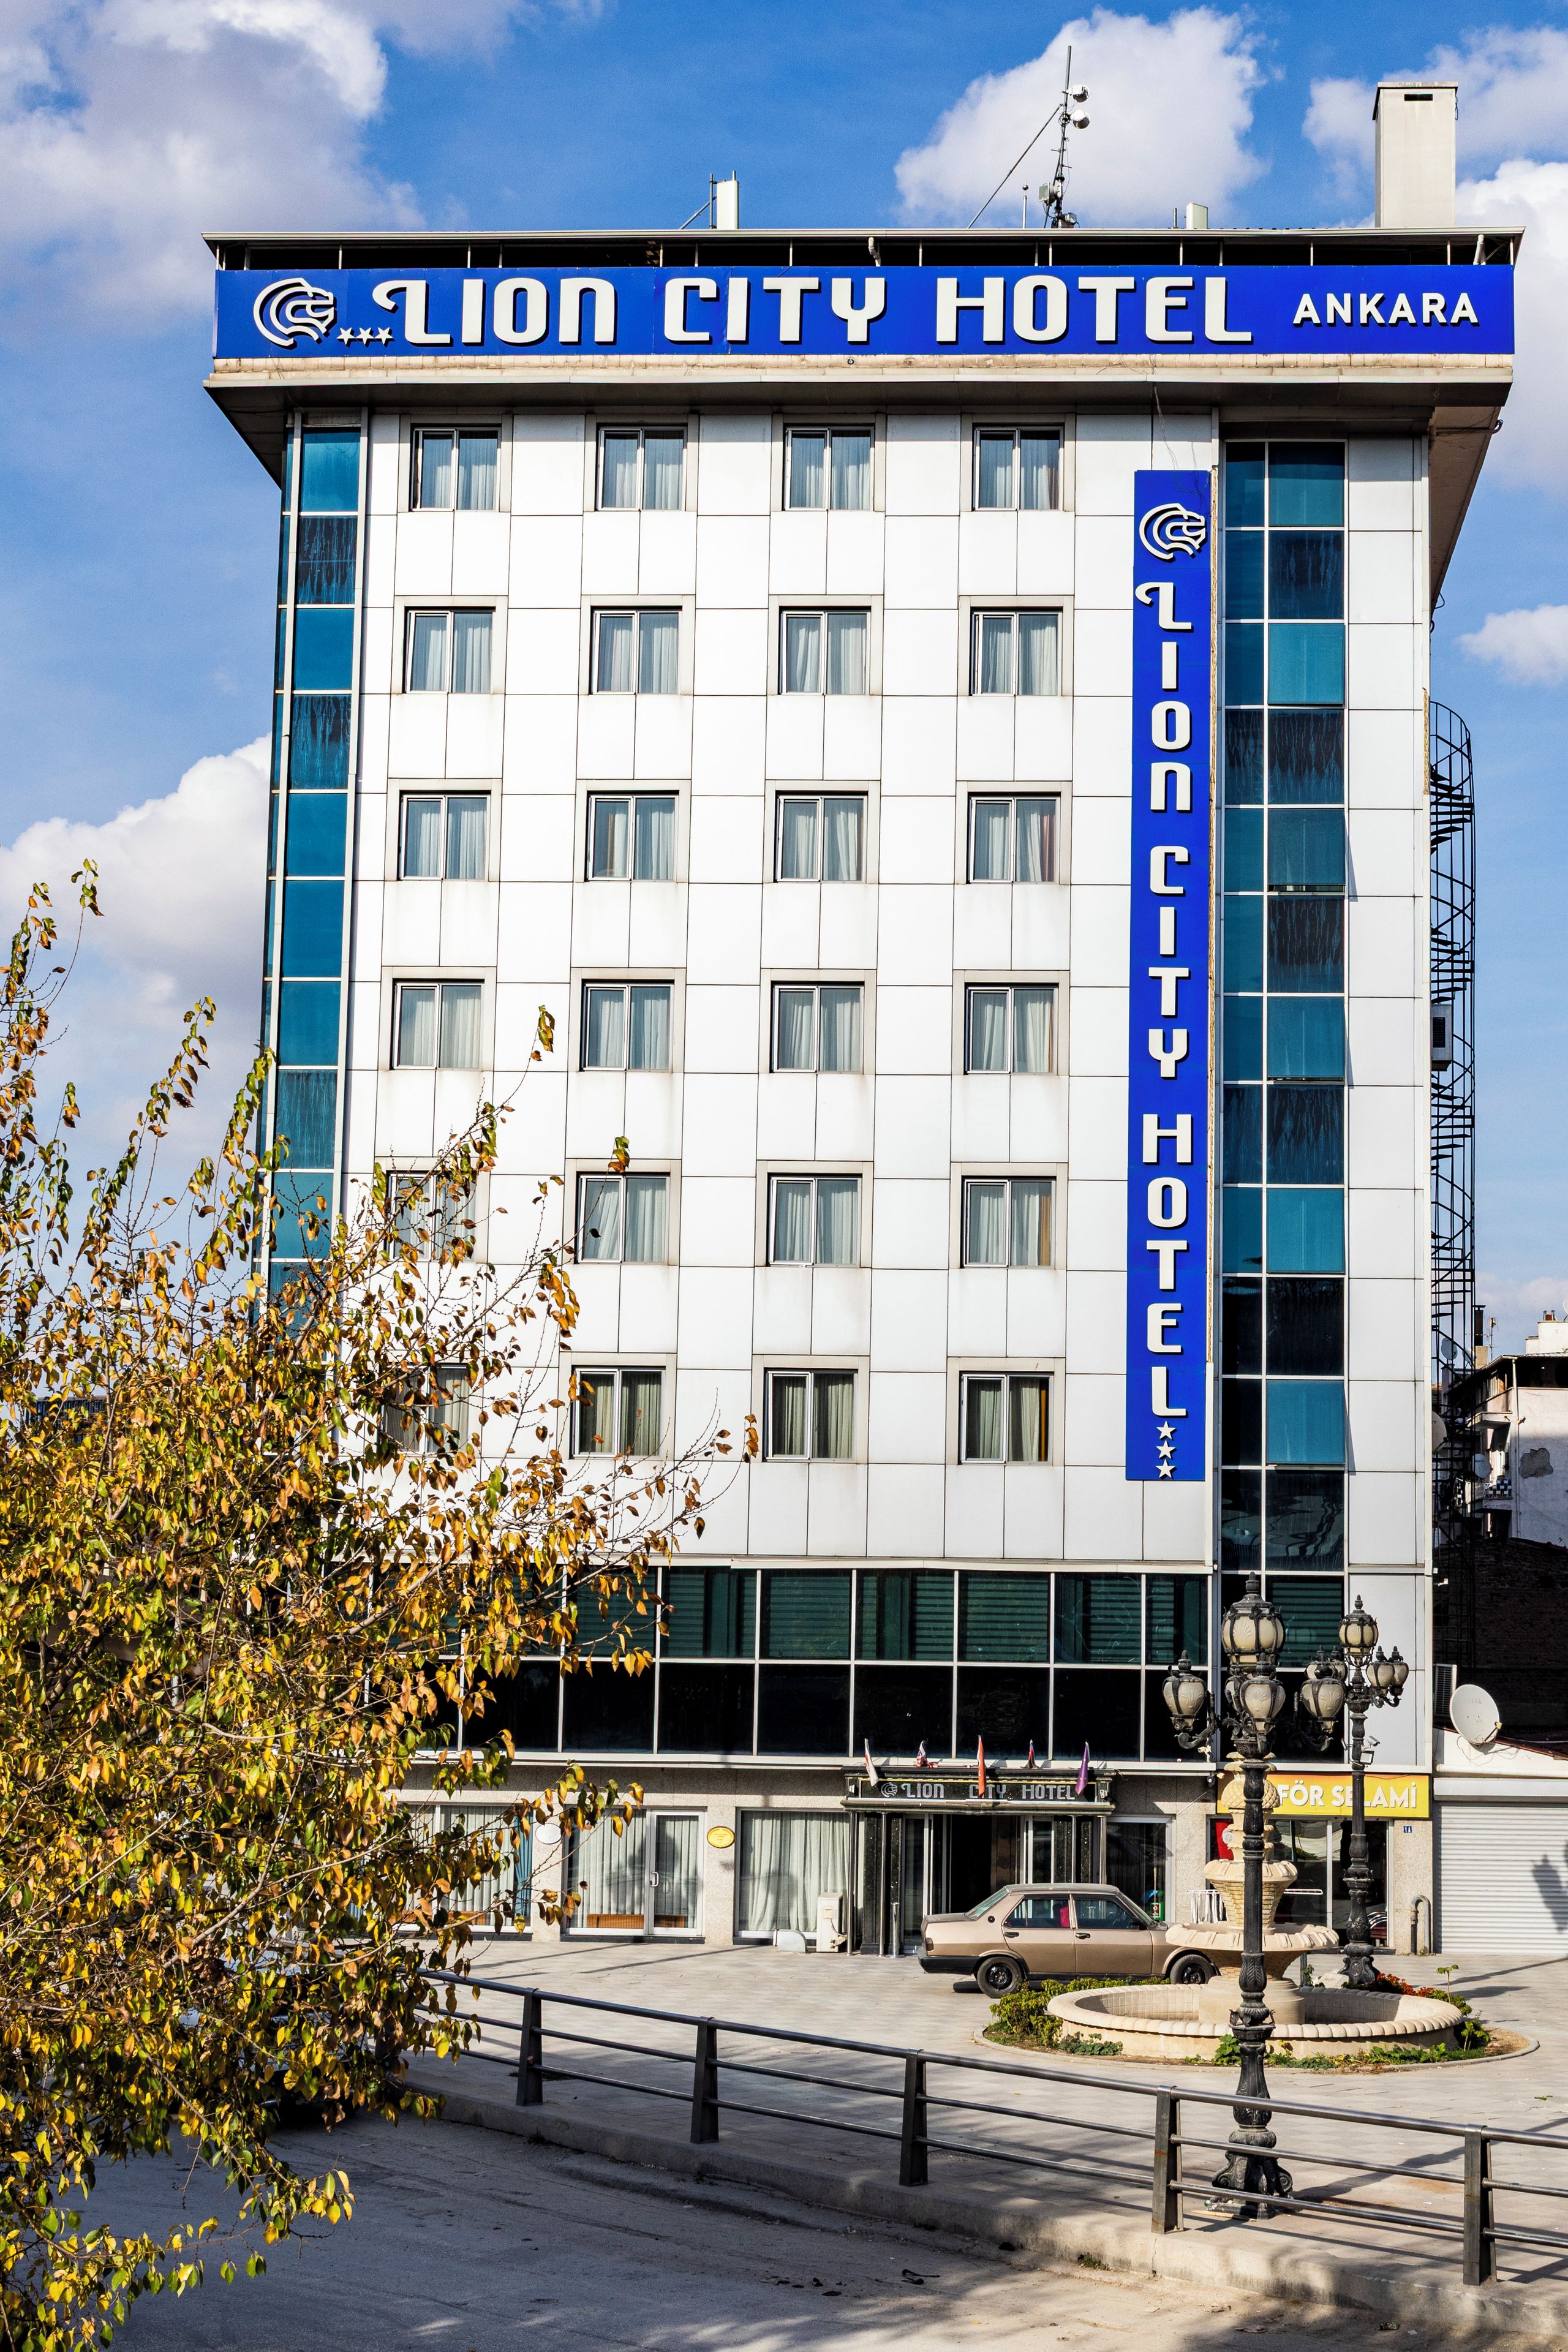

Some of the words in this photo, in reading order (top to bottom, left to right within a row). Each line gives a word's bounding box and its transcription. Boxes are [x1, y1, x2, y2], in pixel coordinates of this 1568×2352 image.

[372, 277, 615, 345] LION
[664, 277, 886, 344] CITY
[936, 276, 1253, 343] HOTEL
[1292, 292, 1479, 325] ANKARA
[1148, 845, 1189, 1078] CITY
[1142, 1113, 1192, 1417] HOTEL
[900, 1782, 944, 1799] LION
[969, 1784, 1007, 1800] CTY
[1022, 1784, 1076, 1801] HOTEL
